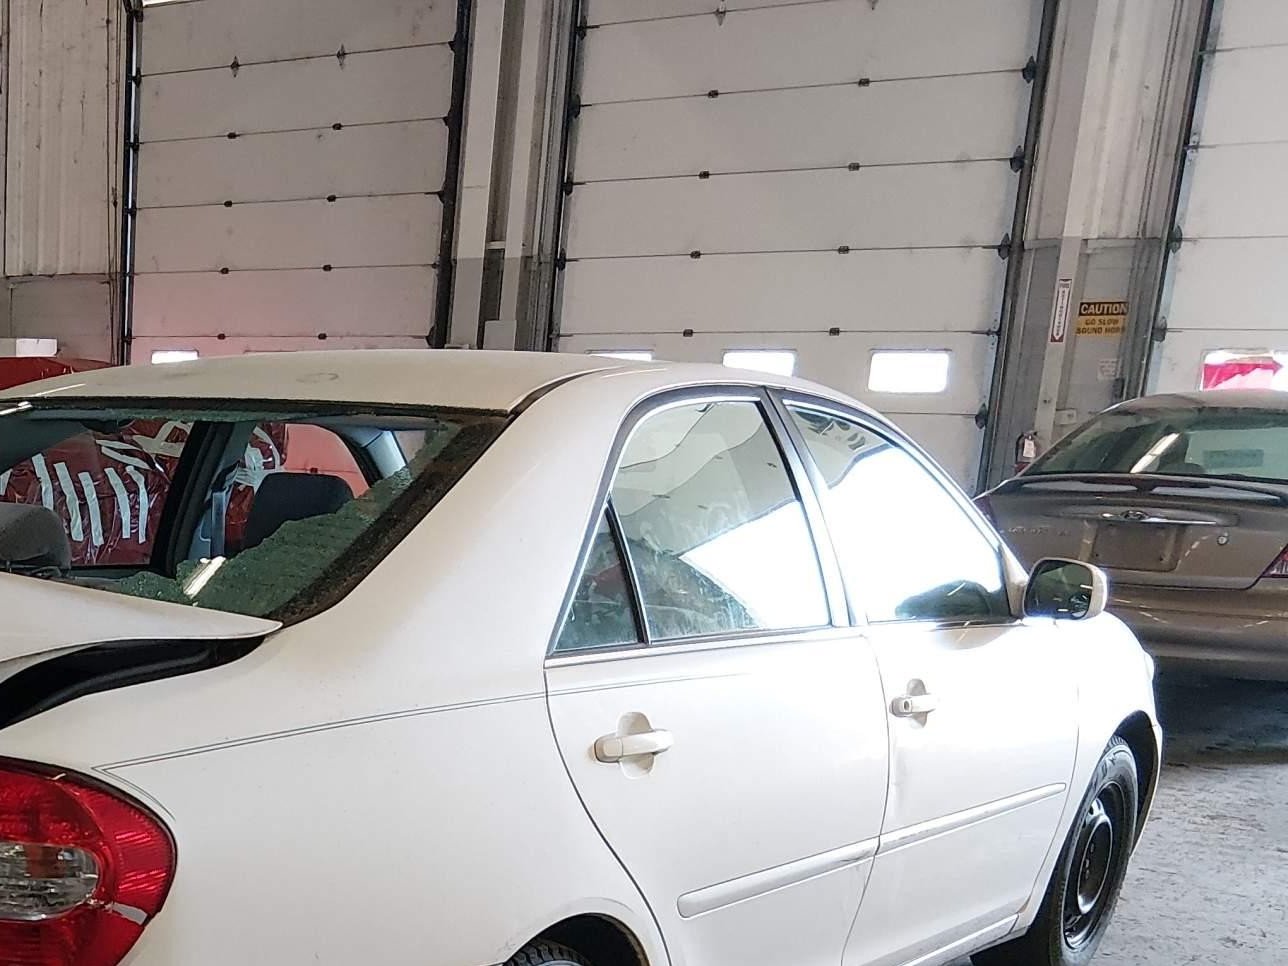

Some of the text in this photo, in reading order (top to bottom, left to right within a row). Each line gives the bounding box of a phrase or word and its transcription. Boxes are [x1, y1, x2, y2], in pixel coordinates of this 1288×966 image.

[1080, 303, 1128, 315] CAUTION
[1085, 318, 1120, 326] GO SLOW
[1075, 326, 1103, 335] SOUND
